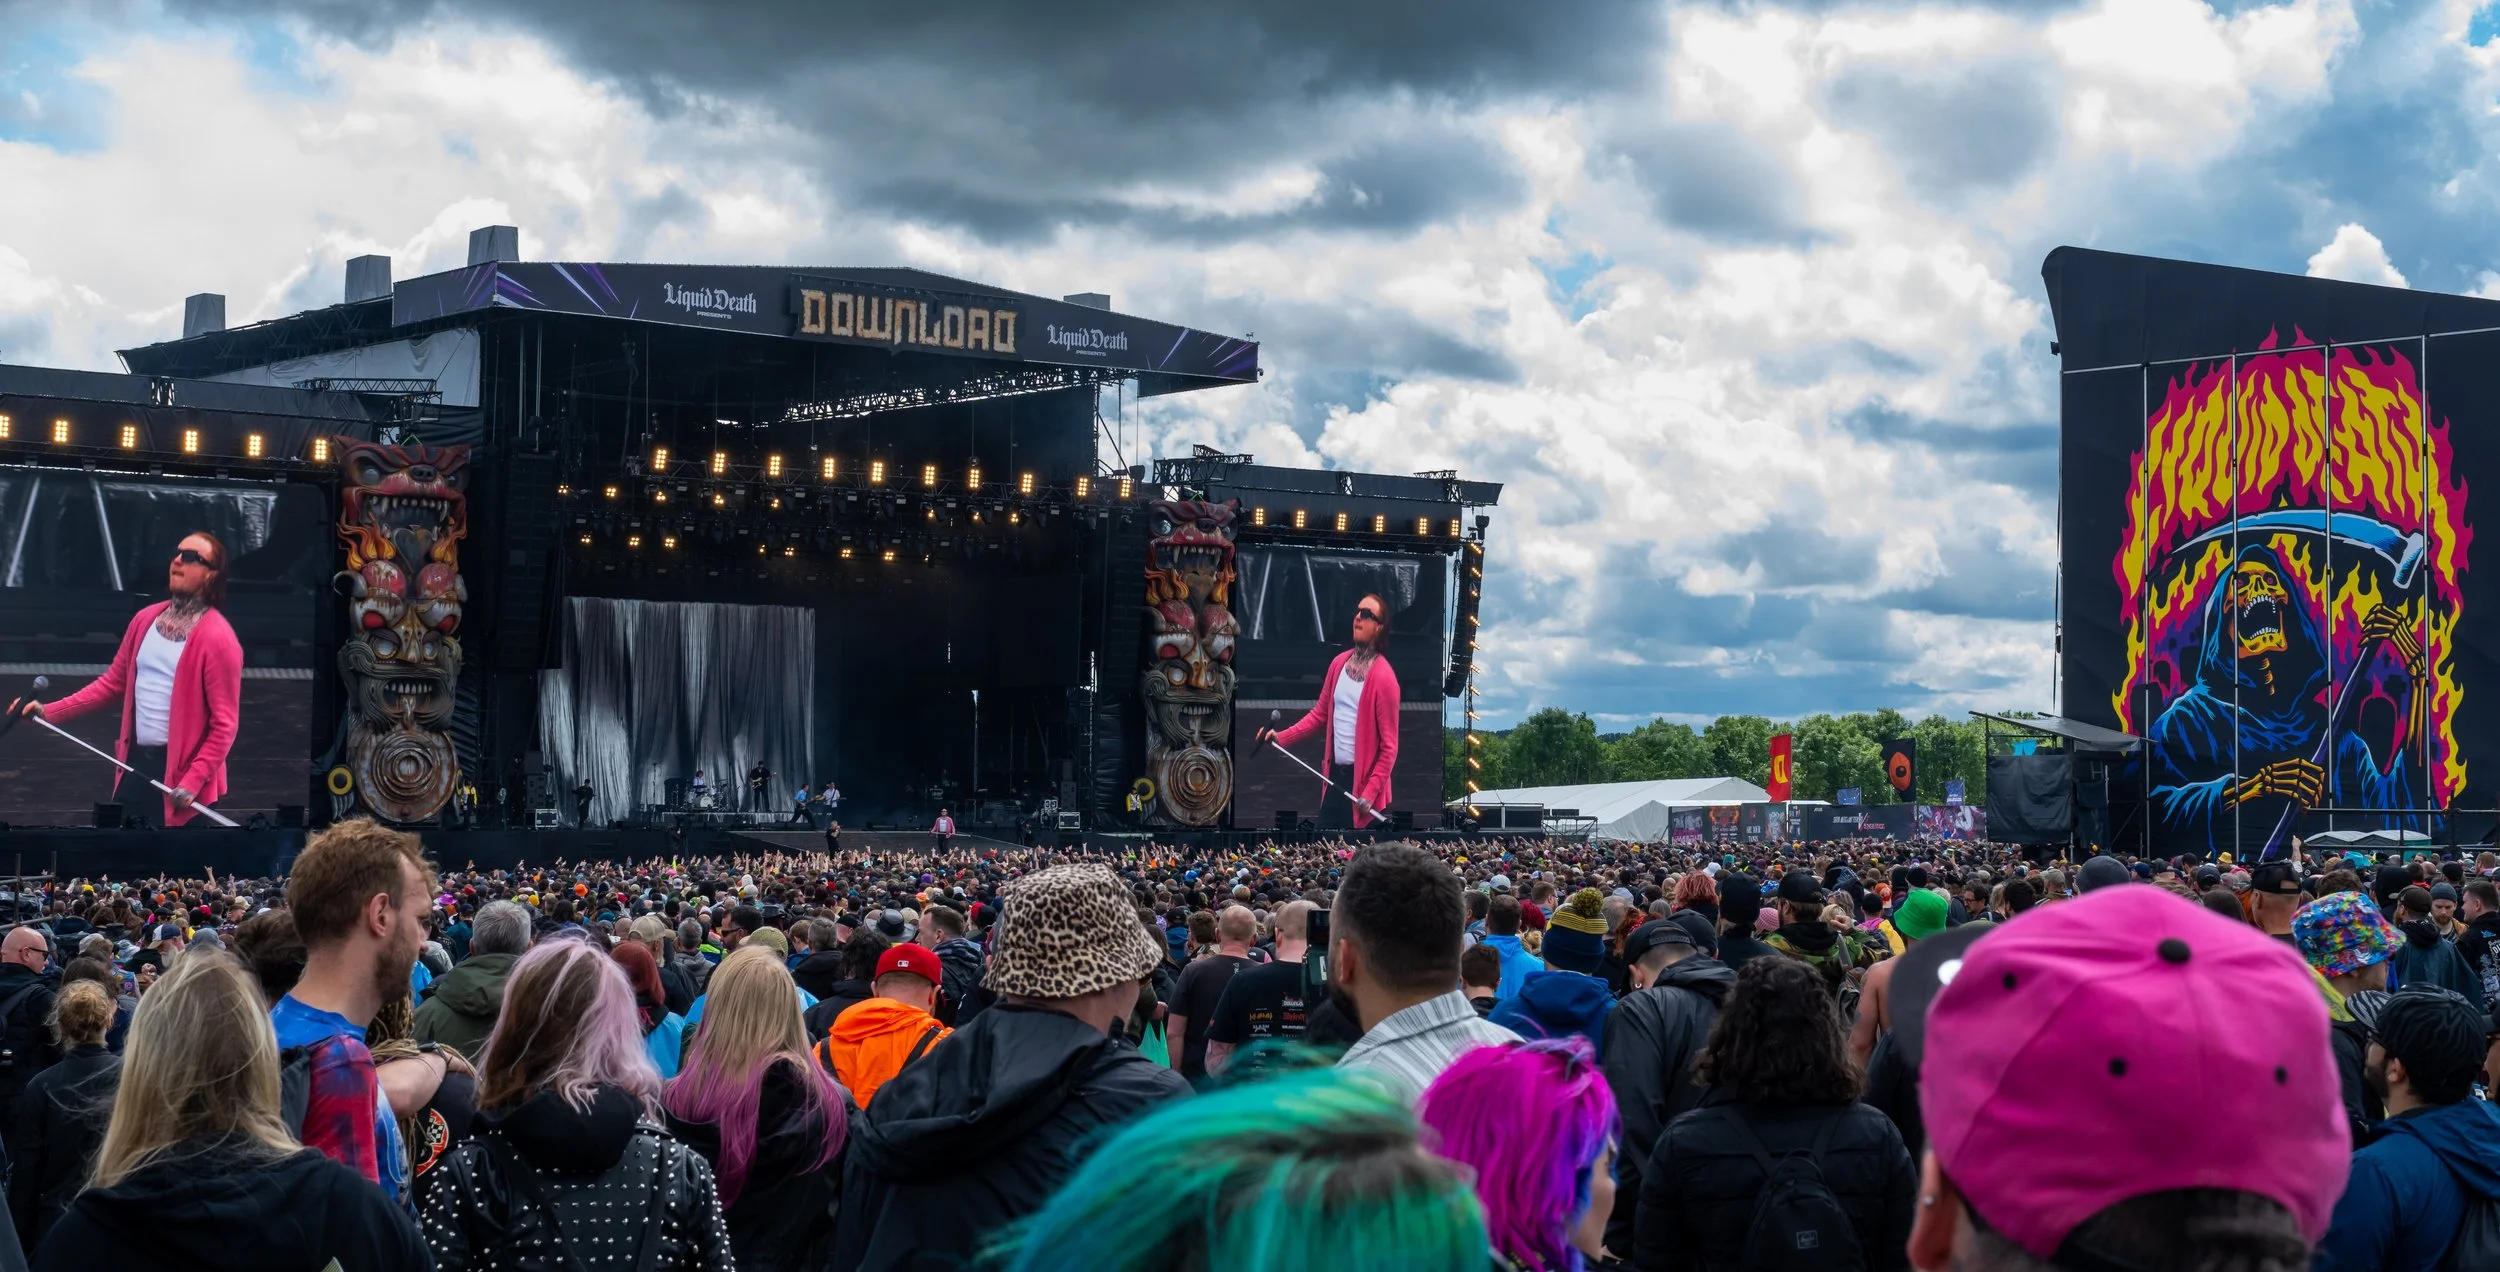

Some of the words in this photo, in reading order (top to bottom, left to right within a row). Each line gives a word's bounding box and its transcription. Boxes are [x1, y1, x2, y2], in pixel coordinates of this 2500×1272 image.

[663, 282, 712, 312] Liquid
[713, 288, 757, 314] Death
[696, 310, 732, 320] PRESENTS
[800, 289, 1018, 354] DOWNLOAD
[1046, 324, 1090, 352] Liquid
[1089, 328, 1128, 351] Death
[1075, 349, 1107, 357] PRESENTS
